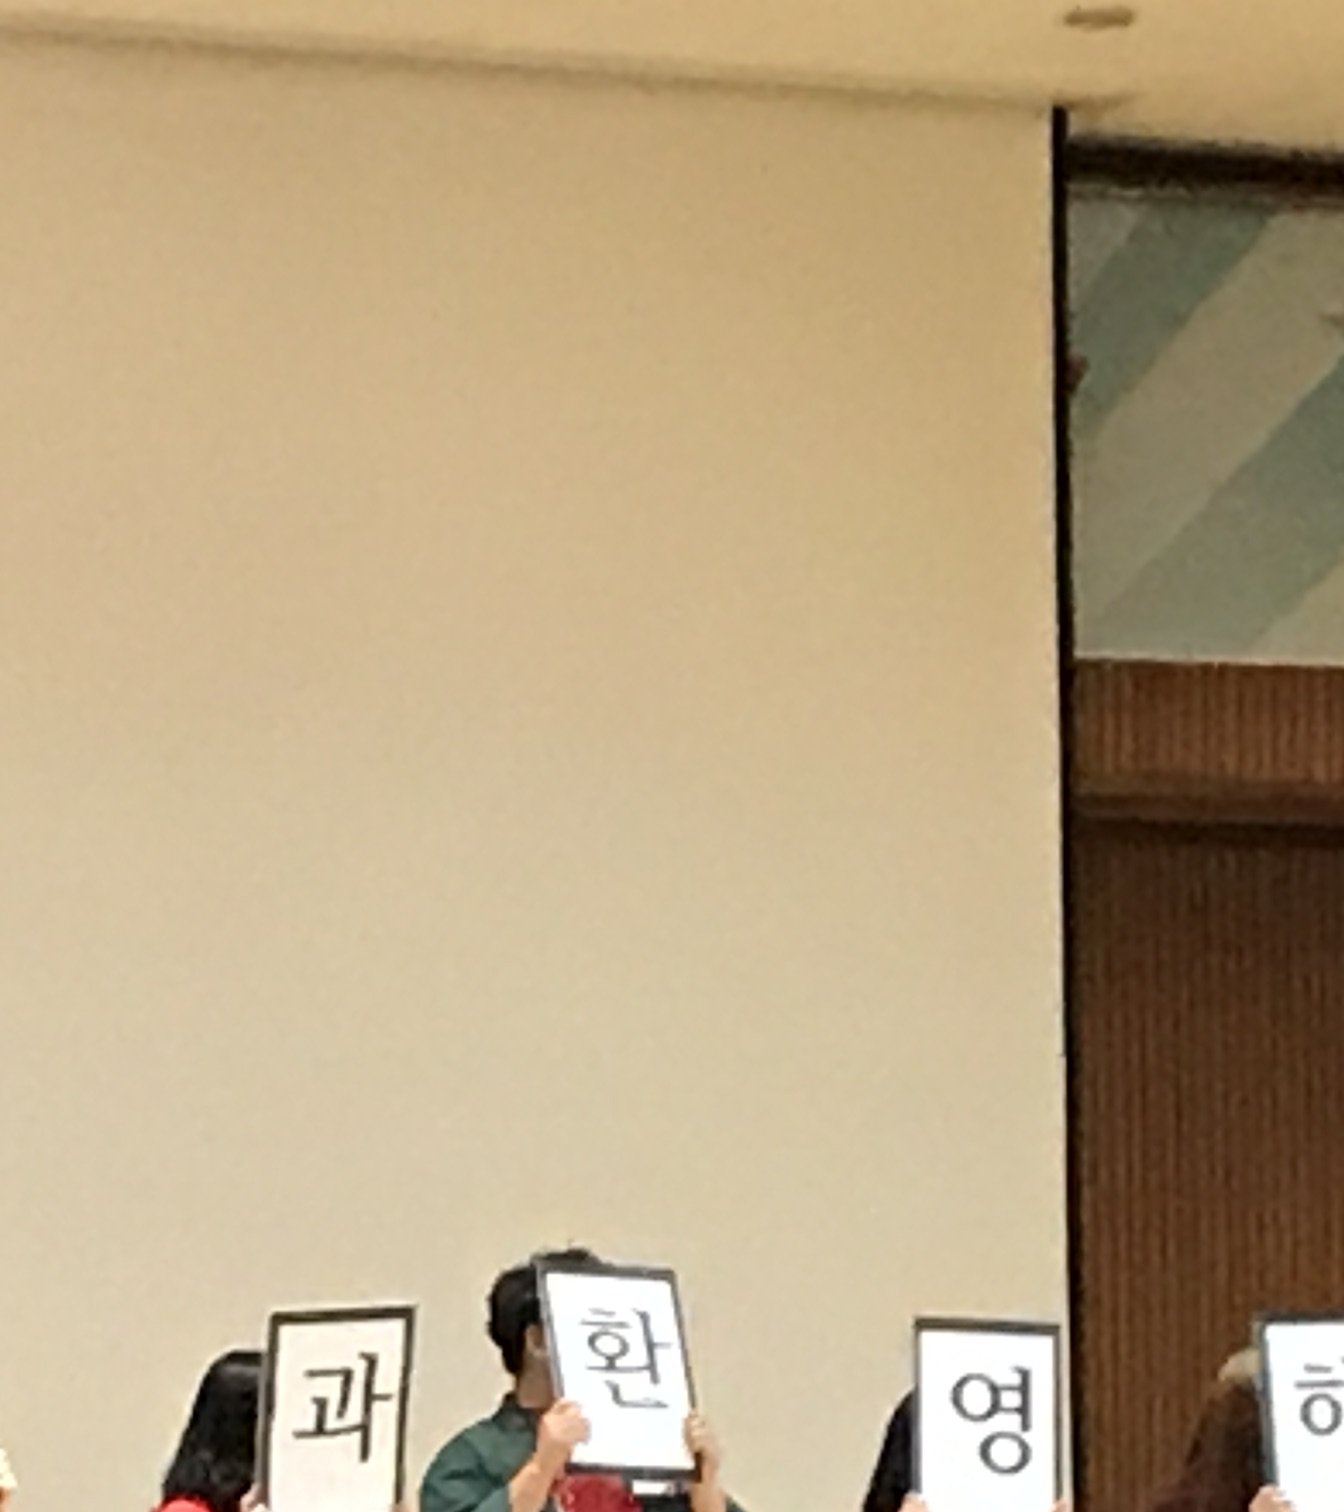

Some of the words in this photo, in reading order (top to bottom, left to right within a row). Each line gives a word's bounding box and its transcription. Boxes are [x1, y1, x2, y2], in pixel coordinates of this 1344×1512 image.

[292, 1350, 393, 1464] 과
[579, 1305, 673, 1411] 환
[950, 1365, 1034, 1476] 영
